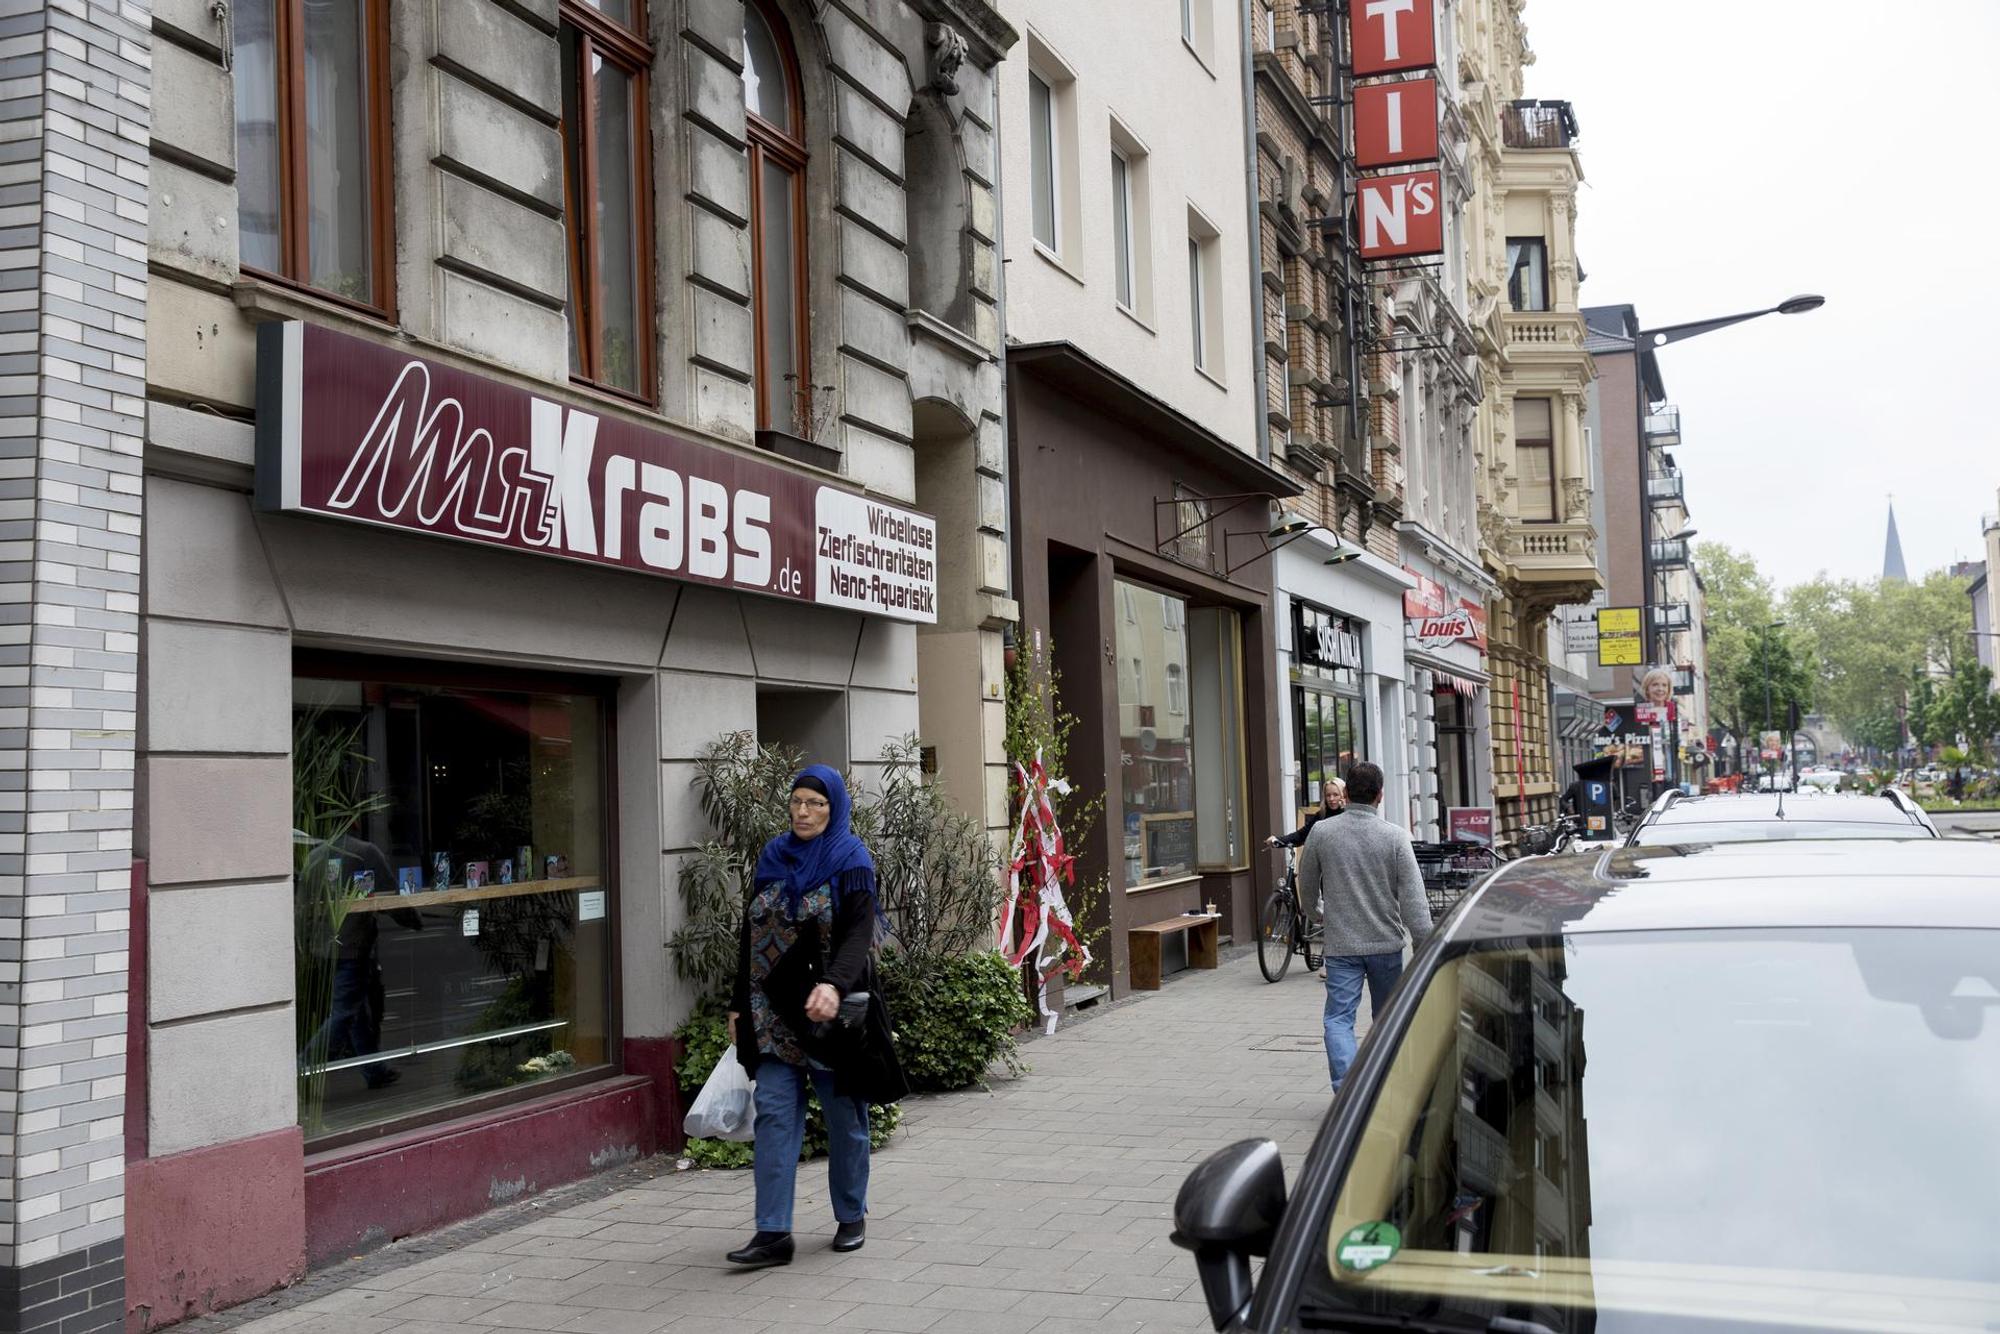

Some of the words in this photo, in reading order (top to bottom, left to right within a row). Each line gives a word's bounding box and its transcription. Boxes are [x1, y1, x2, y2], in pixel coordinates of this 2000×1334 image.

[866, 504, 933, 551] Wirbellose
[818, 526, 934, 582] Zierfischraritäten
[830, 564, 934, 614] Nano-Aquaristik
[1317, 624, 1341, 665] SUSHI
[1420, 618, 1466, 637] Louis
[1592, 783, 1603, 801] P
